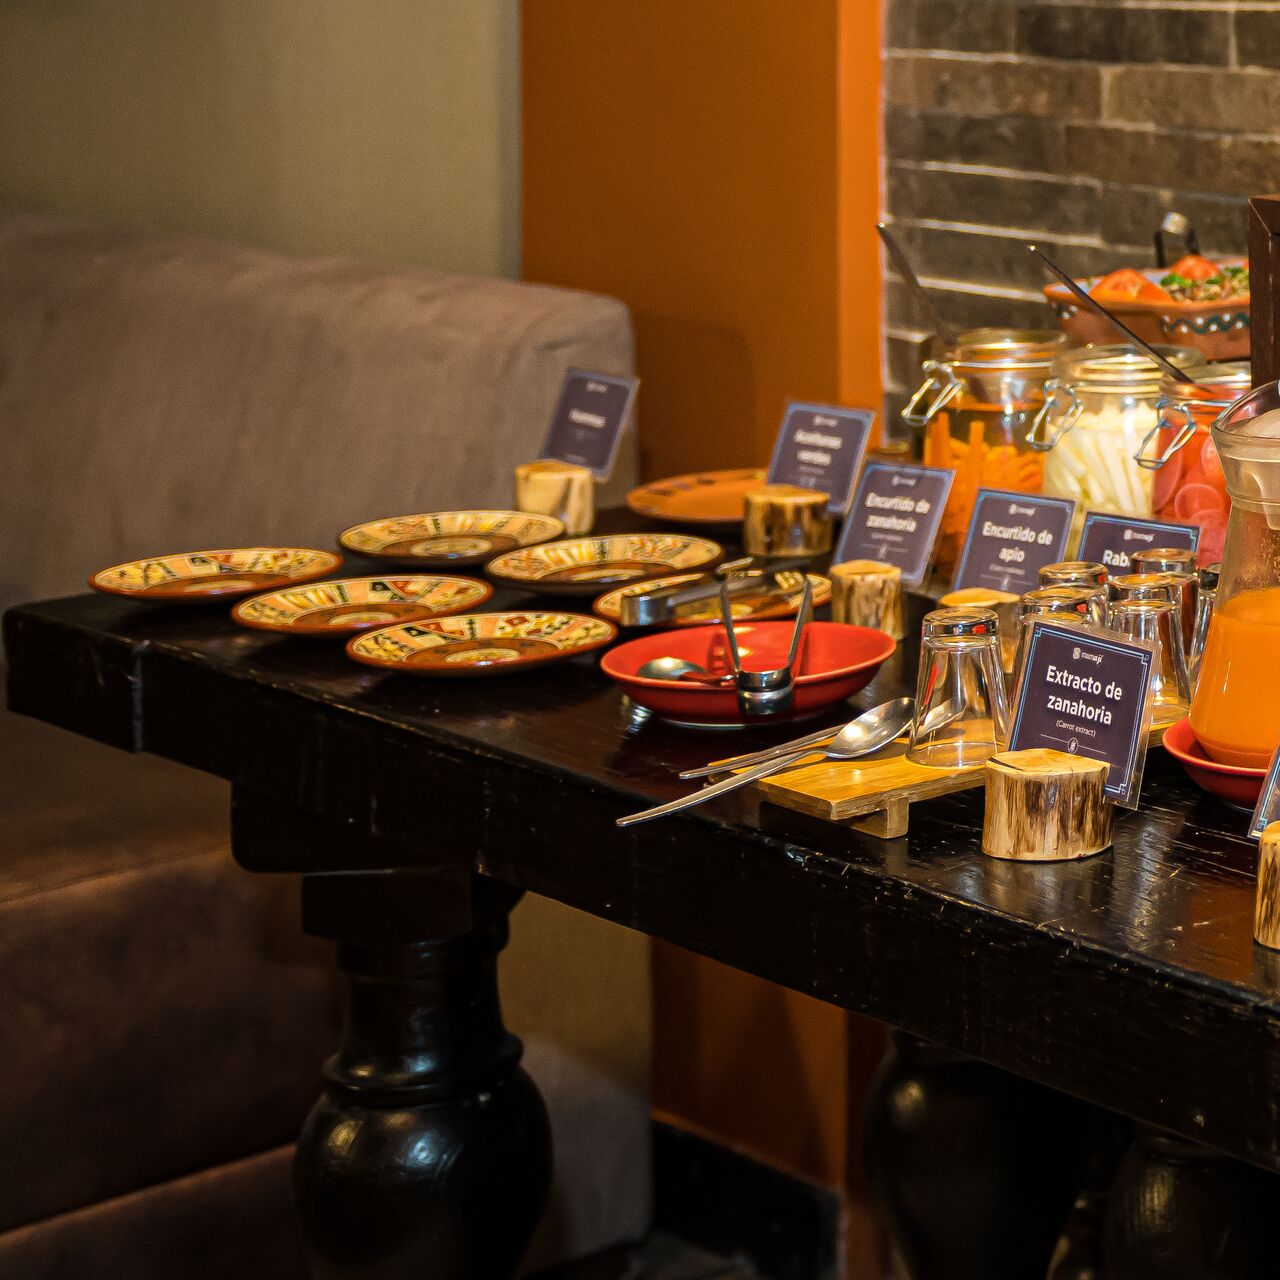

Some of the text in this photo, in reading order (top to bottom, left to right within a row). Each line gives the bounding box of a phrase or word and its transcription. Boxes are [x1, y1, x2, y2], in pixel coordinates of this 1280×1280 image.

[982, 521, 1052, 545] Encurtido de
[998, 546, 1024, 563] apio
[1046, 664, 1122, 700] Extracto de
[1047, 694, 1112, 725] zanahoria
[1055, 719, 1096, 737] (Carrot extract)
